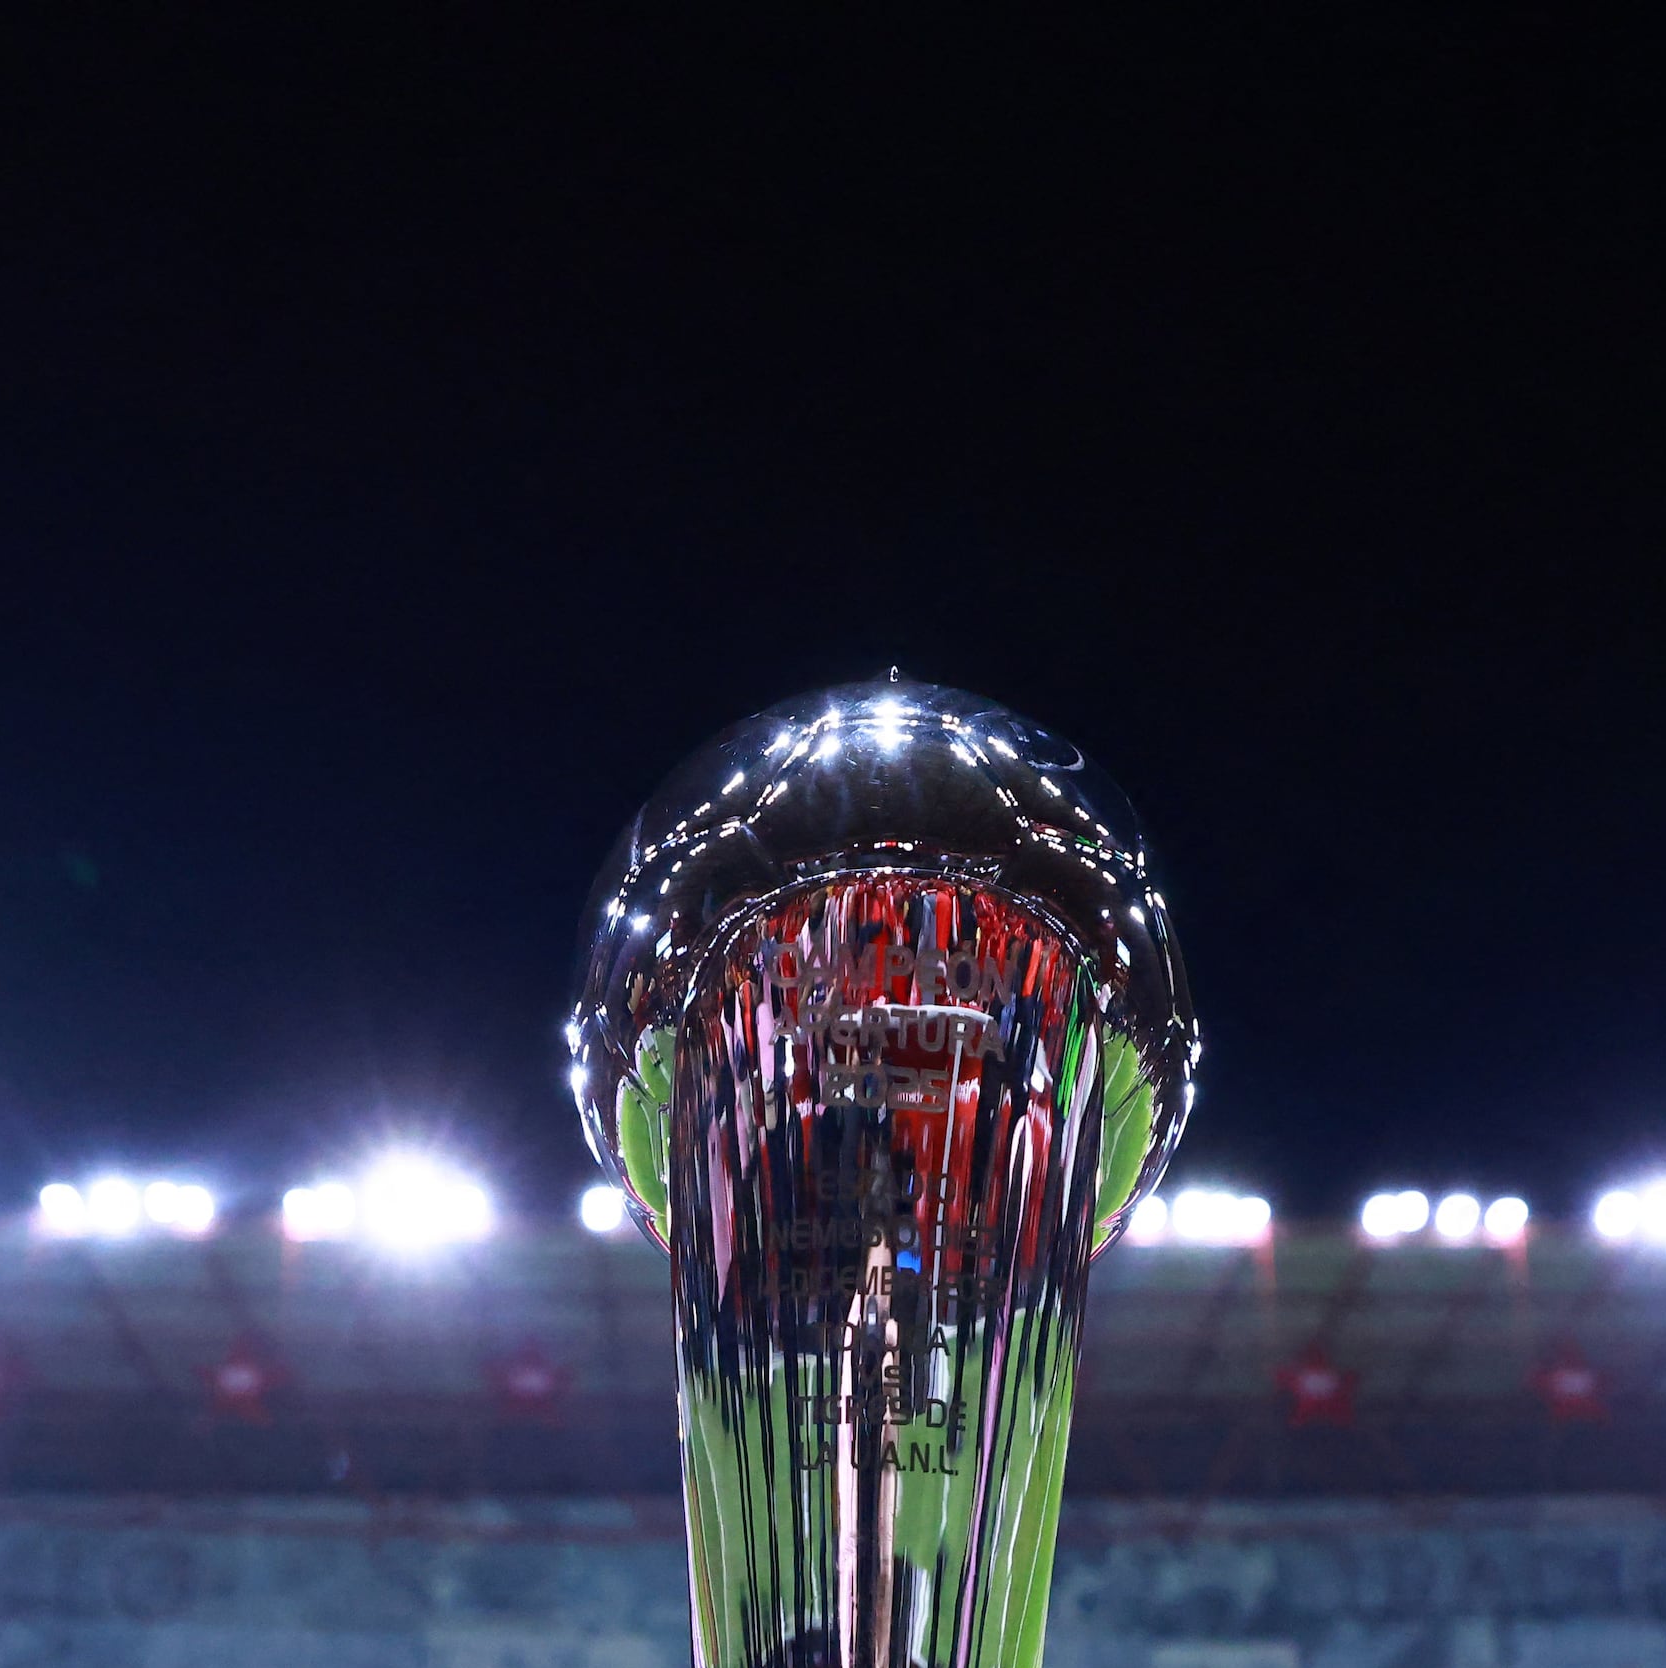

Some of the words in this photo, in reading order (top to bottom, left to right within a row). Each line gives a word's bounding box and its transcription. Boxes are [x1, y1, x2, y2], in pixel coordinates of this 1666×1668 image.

[769, 1003, 1006, 1063] APERTURA
[824, 1064, 950, 1114] 2025
[792, 1394, 913, 1426] TIGRES
[926, 1398, 967, 1432] DE
[796, 1440, 836, 1471] LA
[850, 1440, 959, 1476] UA.N.L.
